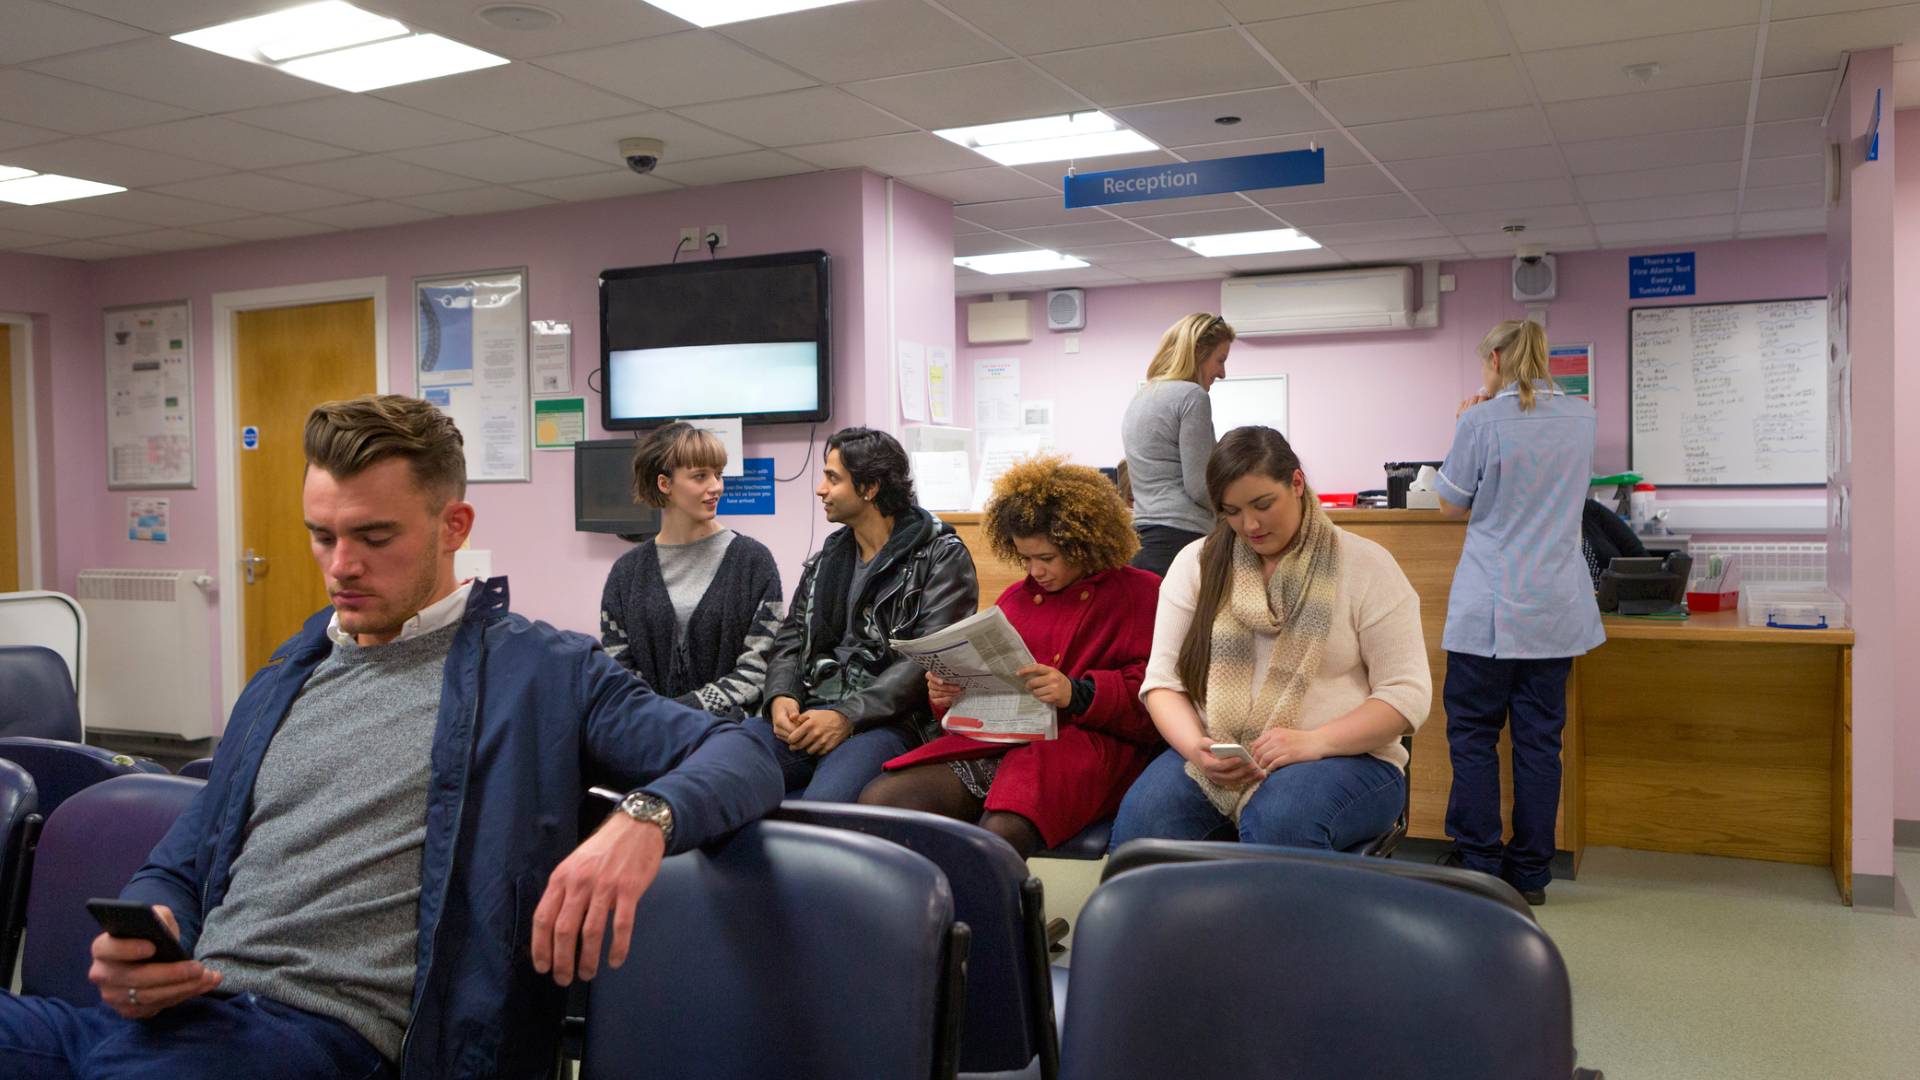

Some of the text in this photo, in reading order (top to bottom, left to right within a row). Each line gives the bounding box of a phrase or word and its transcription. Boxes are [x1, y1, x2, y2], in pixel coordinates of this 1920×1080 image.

[1103, 171, 1197, 194] Reception
[1650, 267, 1674, 275] Alarm
[1676, 265, 1691, 273] Test
[1651, 277, 1673, 285] Every
[1639, 284, 1687, 295] Tuesday AM
